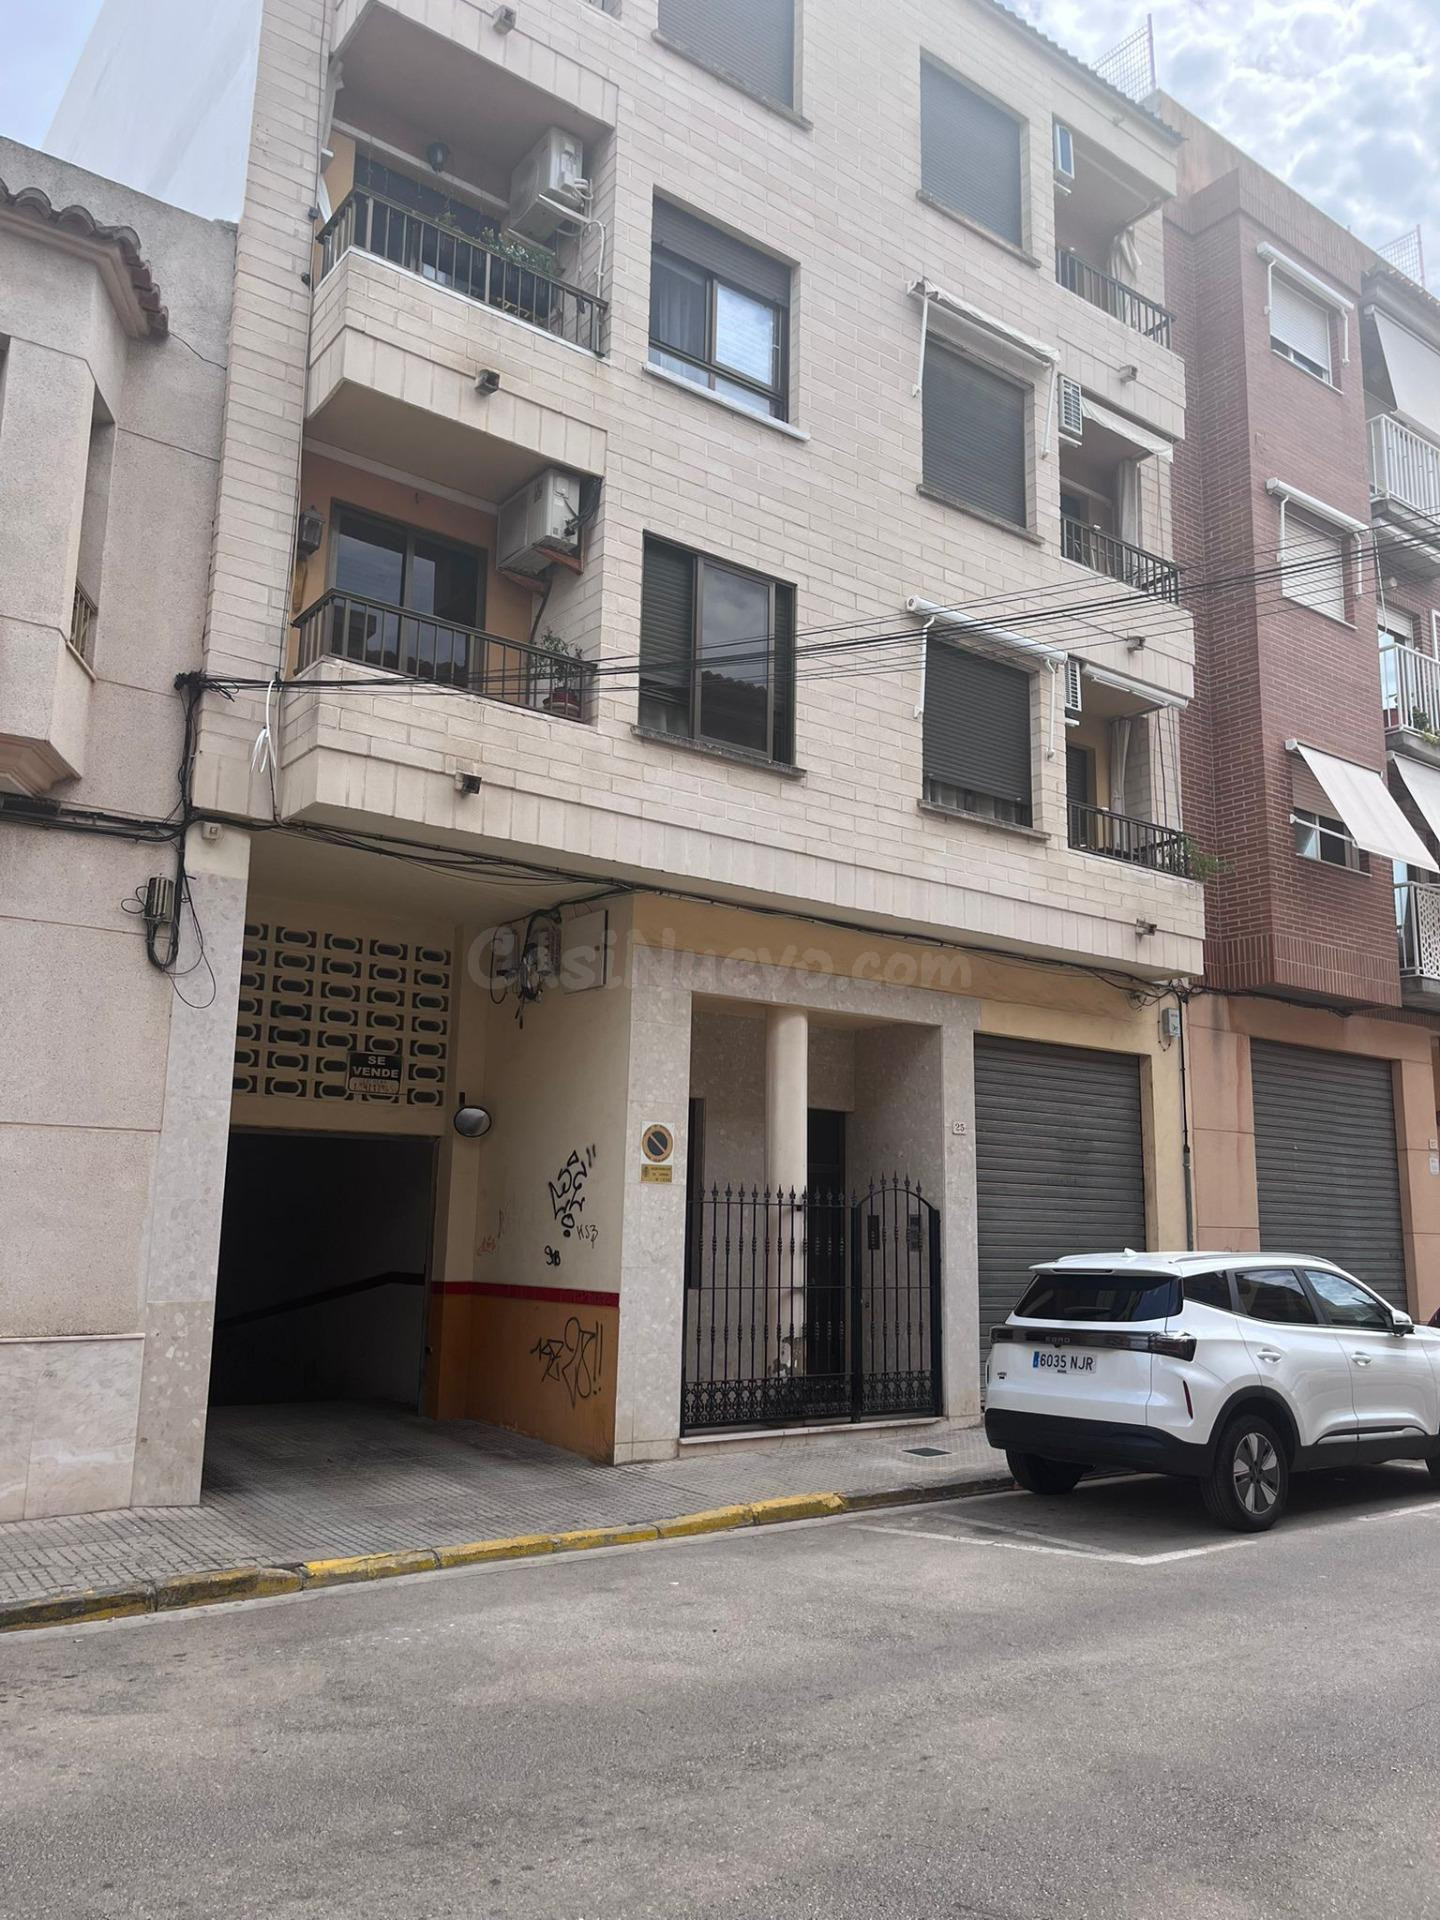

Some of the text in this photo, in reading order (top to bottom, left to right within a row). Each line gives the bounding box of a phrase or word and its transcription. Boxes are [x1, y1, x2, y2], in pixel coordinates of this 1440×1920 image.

[368, 1056, 386, 1065] SE
[352, 1066, 400, 1078] VENDE
[955, 1123, 965, 1132] 25
[1040, 1353, 1094, 1371] 6035 NJR
